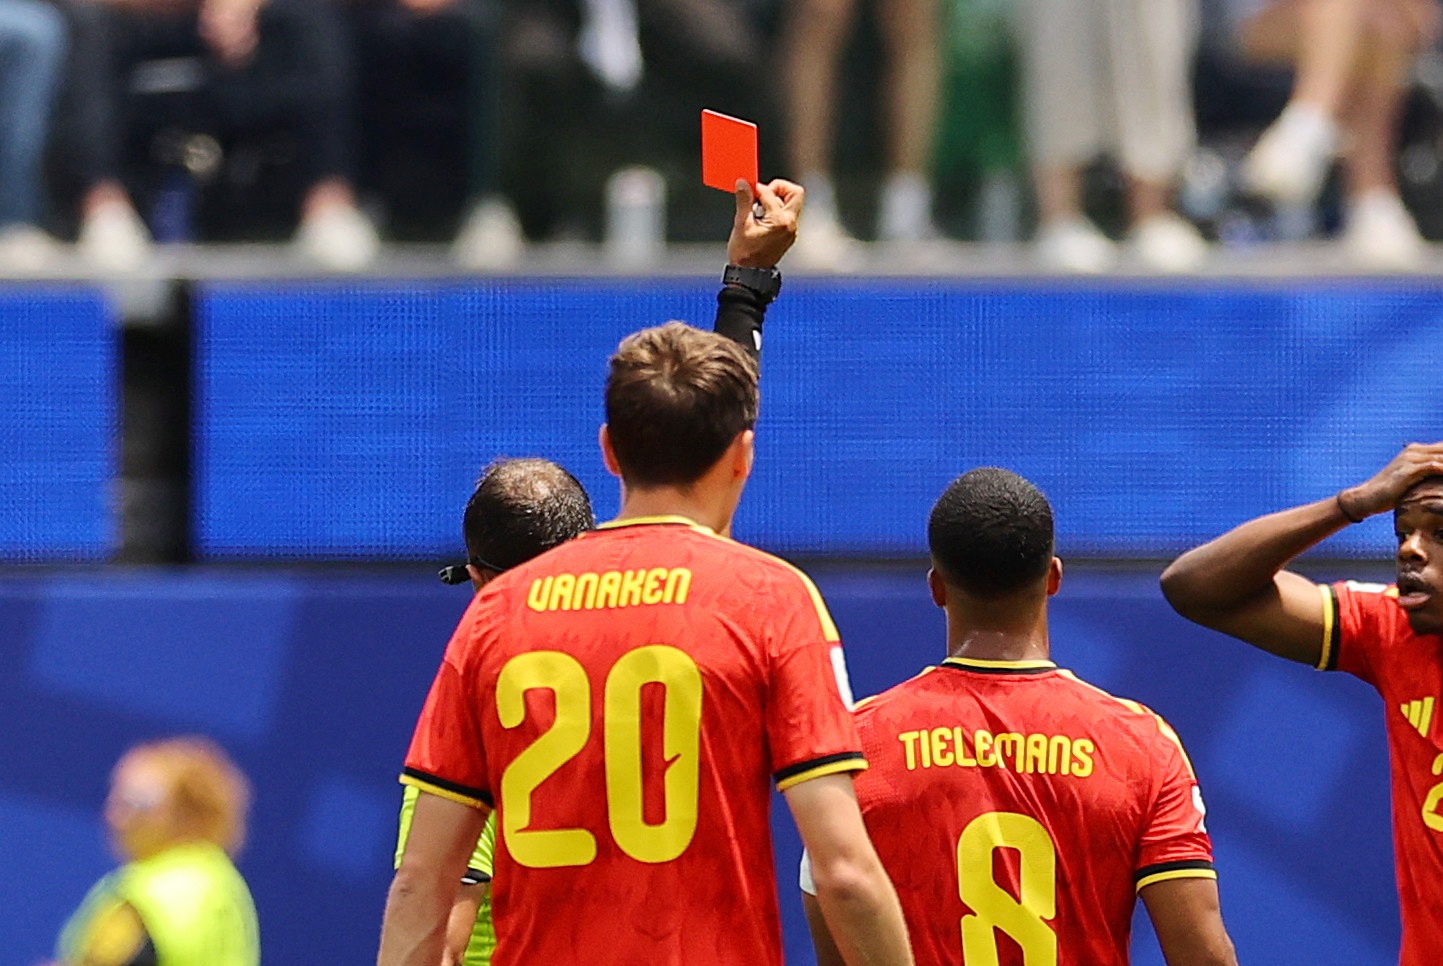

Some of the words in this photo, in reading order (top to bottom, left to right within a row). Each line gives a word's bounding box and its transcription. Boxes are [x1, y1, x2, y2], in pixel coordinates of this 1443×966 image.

[527, 567, 692, 612] VANAKEN
[496, 644, 703, 868] 20
[898, 727, 1095, 778] TIELEMANS
